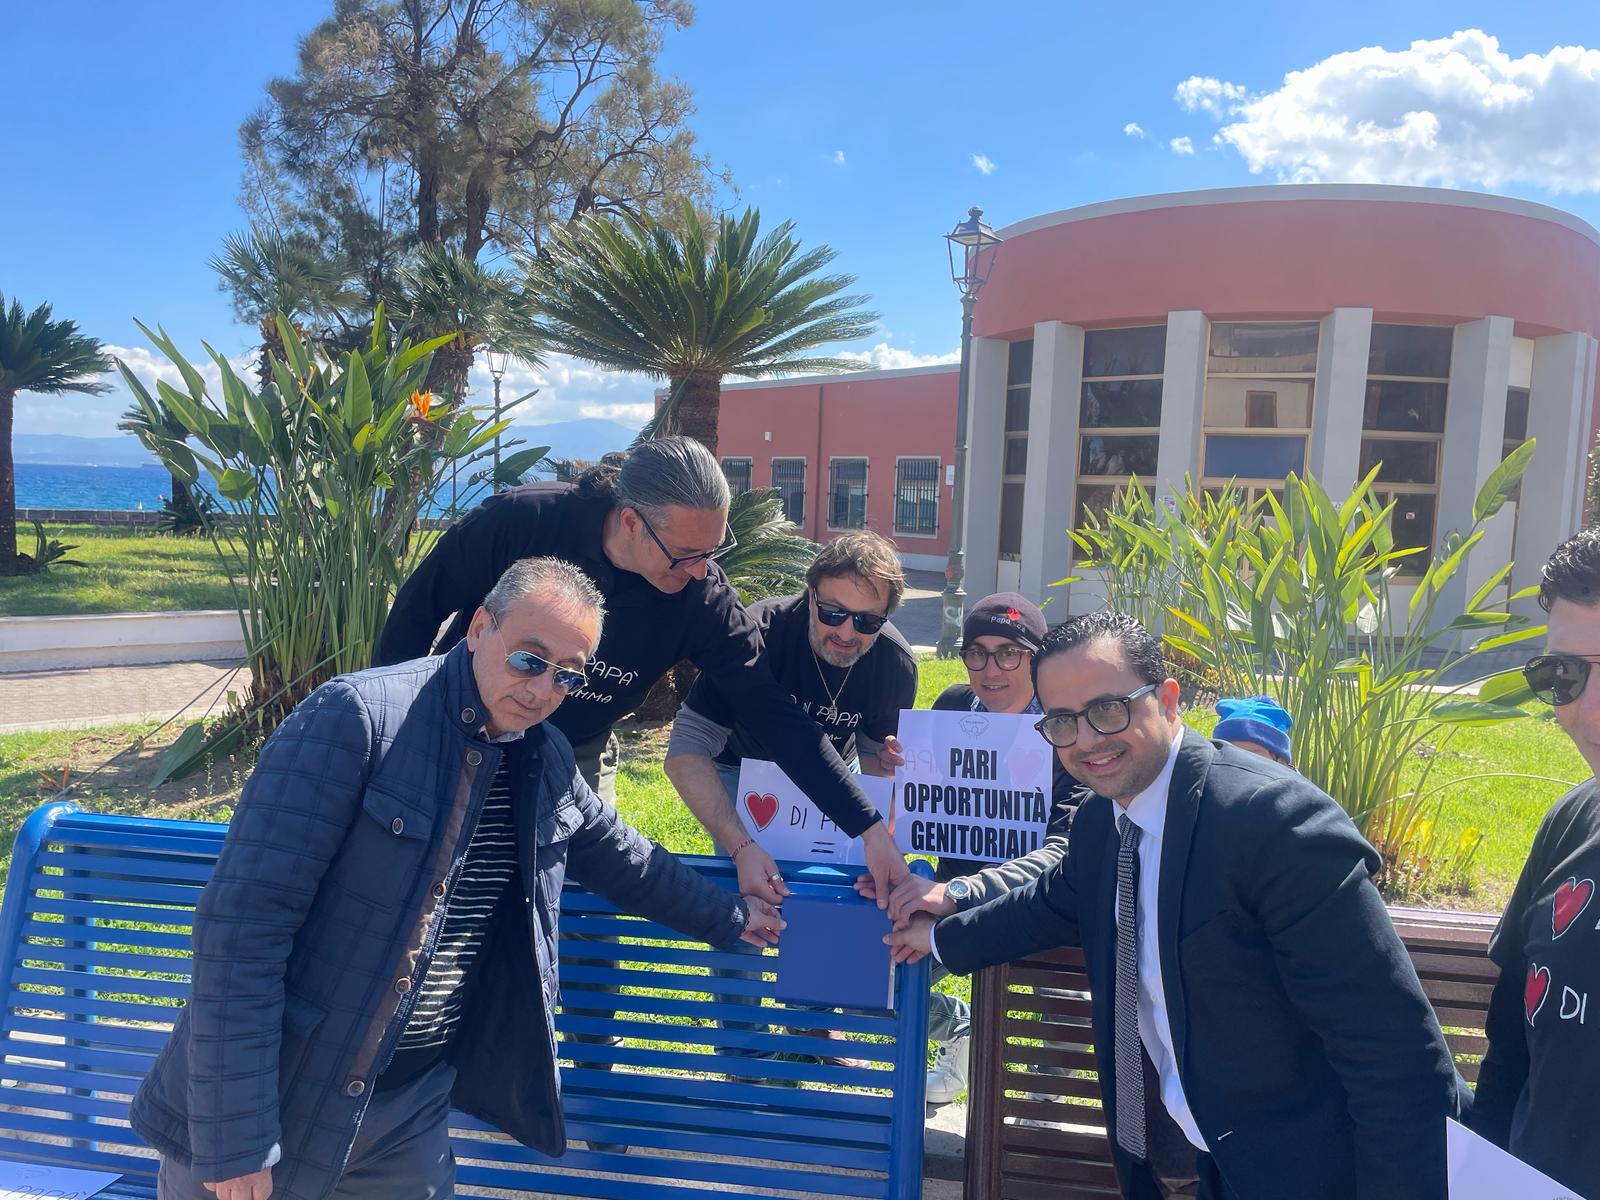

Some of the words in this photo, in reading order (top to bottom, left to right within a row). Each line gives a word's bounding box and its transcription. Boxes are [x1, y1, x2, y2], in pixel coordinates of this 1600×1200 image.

[949, 747, 998, 781] PARI
[790, 805, 808, 830] DI
[903, 781, 1047, 824] OPPORTUNITÀ
[1559, 985, 1588, 1025] DI
